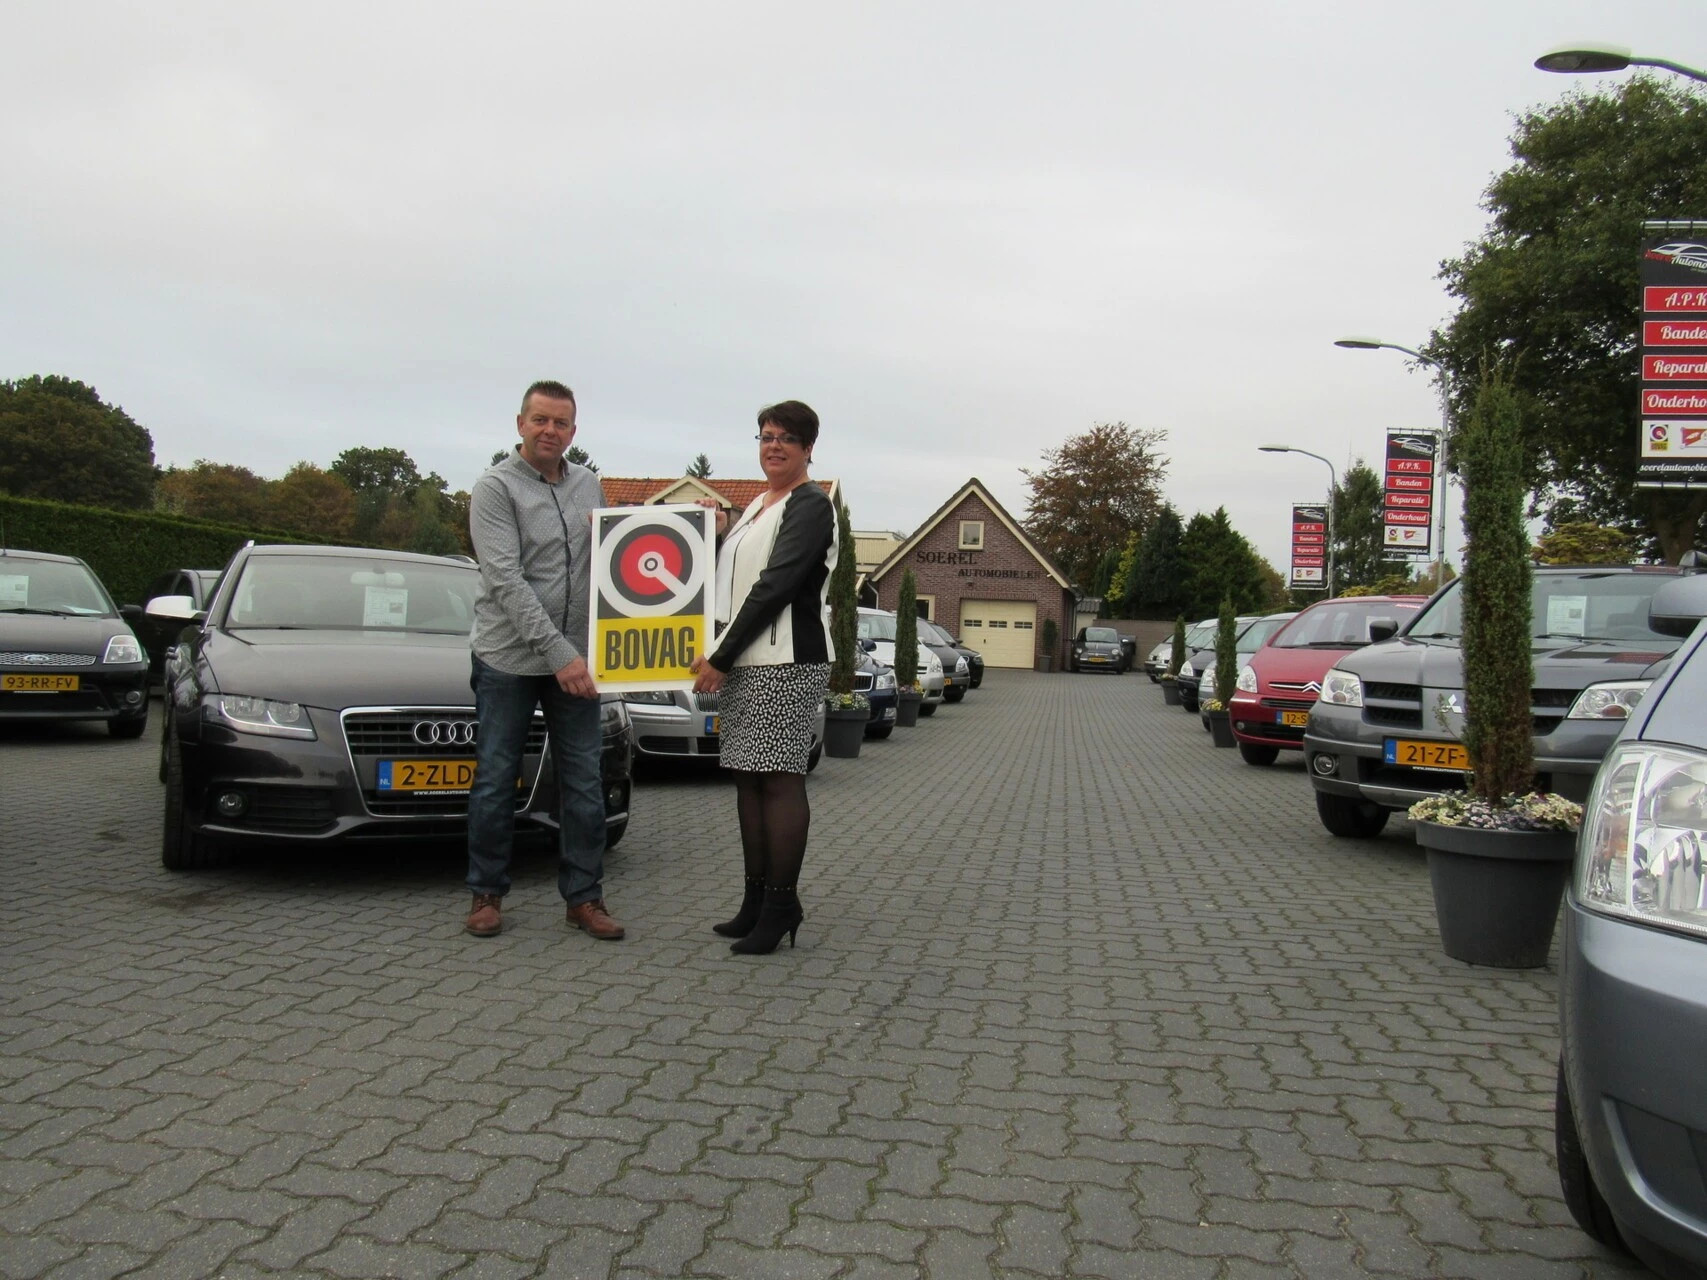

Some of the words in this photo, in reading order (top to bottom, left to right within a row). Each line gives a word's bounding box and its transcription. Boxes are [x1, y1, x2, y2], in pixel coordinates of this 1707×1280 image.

[1660, 325, 1707, 340] Bande
[1395, 478, 1423, 487] Banden
[1391, 495, 1425, 505] Reparatie
[1387, 512, 1427, 521] Onderhoud
[916, 551, 977, 565] SOEREL
[958, 568, 1041, 579] AUTOMOBIELEN
[605, 626, 695, 670] BOVAG
[6, 676, 73, 688] 93-RR-FV
[1286, 713, 1308, 724] 12-S
[1407, 744, 1465, 765] 21-ZF-
[379, 778, 391, 786] NL
[402, 764, 475, 786] 2-ZLD
